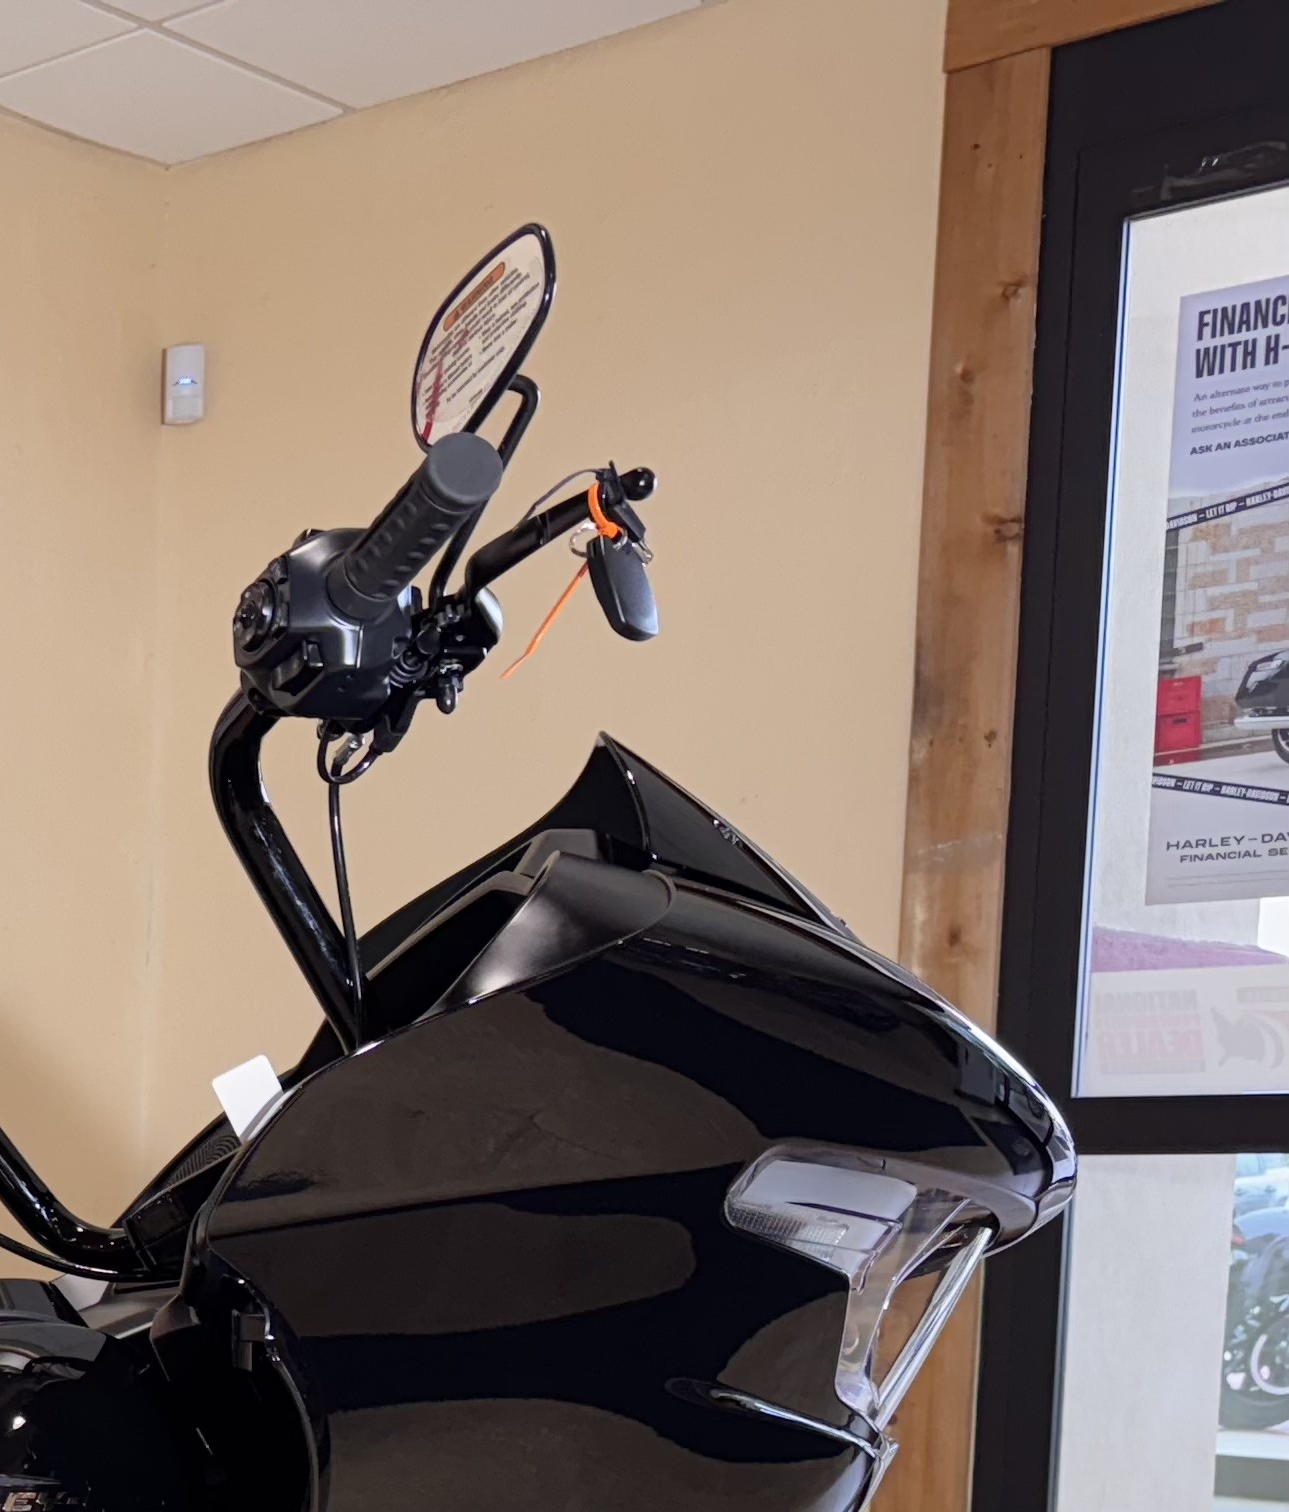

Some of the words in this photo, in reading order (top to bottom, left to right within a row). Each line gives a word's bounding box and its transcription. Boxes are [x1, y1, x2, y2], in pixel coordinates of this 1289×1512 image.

[1196, 293, 1289, 342] FINANC
[1195, 338, 1258, 379] WITH
[1190, 444, 1213, 456] ASK
[1214, 441, 1232, 452] AN
[1166, 832, 1289, 851] HARLEY-DA
[1180, 850, 1262, 864] FINANCIAL
